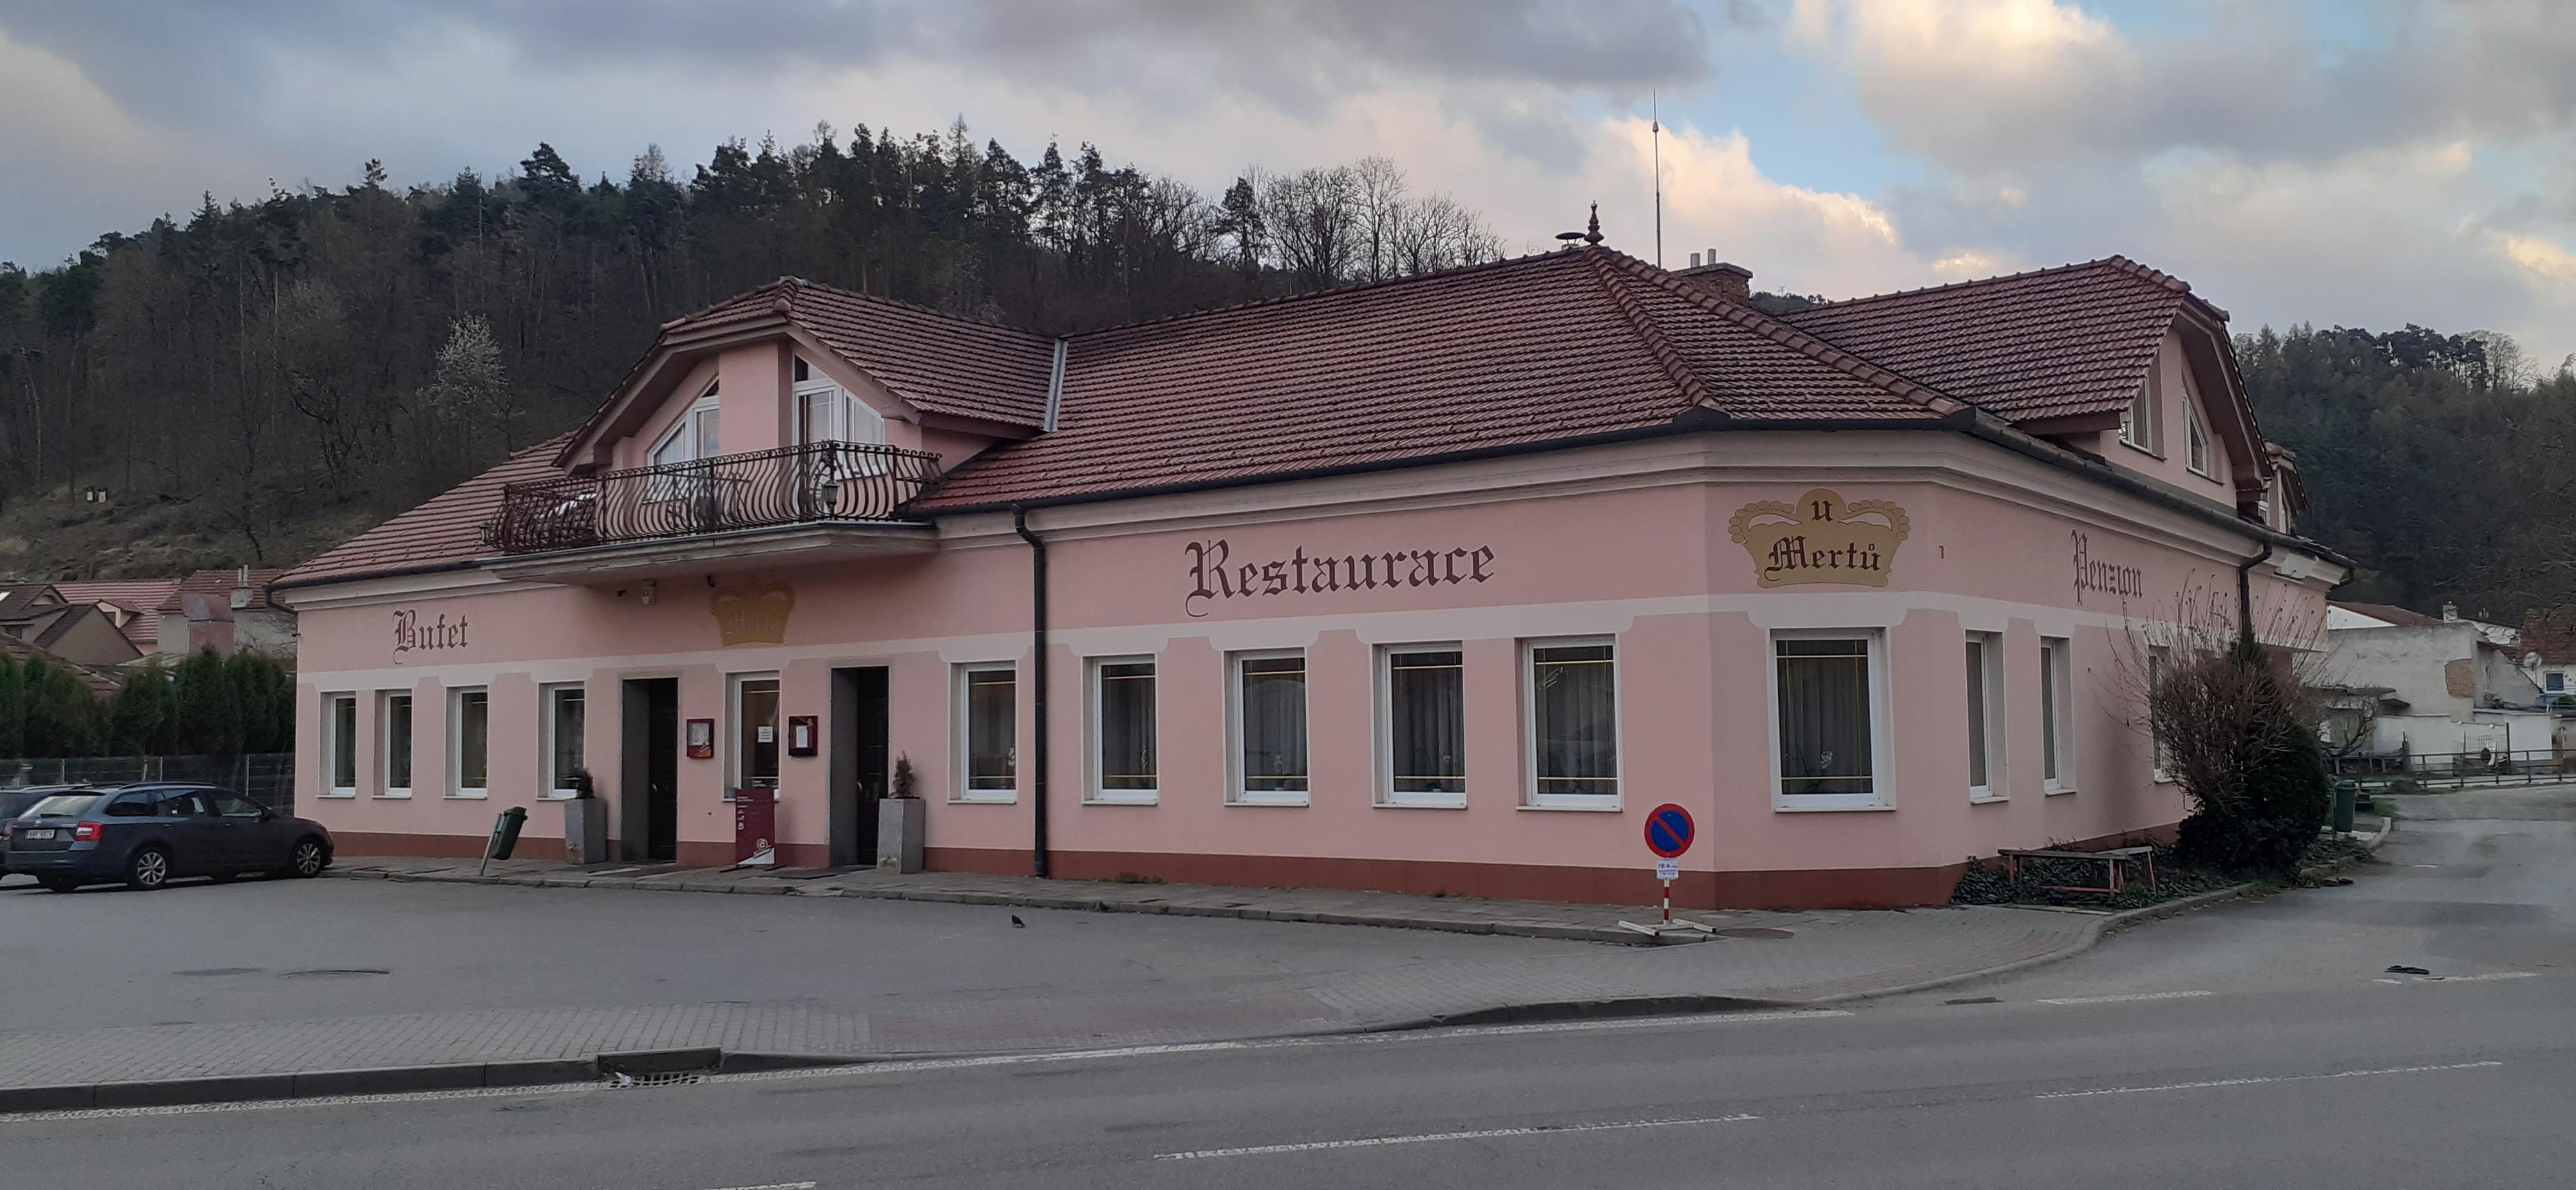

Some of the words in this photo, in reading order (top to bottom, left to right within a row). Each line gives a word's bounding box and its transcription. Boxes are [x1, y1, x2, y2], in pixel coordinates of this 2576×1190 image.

[1185, 538, 1495, 618] Restaurace
[1765, 535, 1881, 581] Mertů
[2071, 529, 2143, 606] Penzion
[392, 609, 469, 665] Bufet
